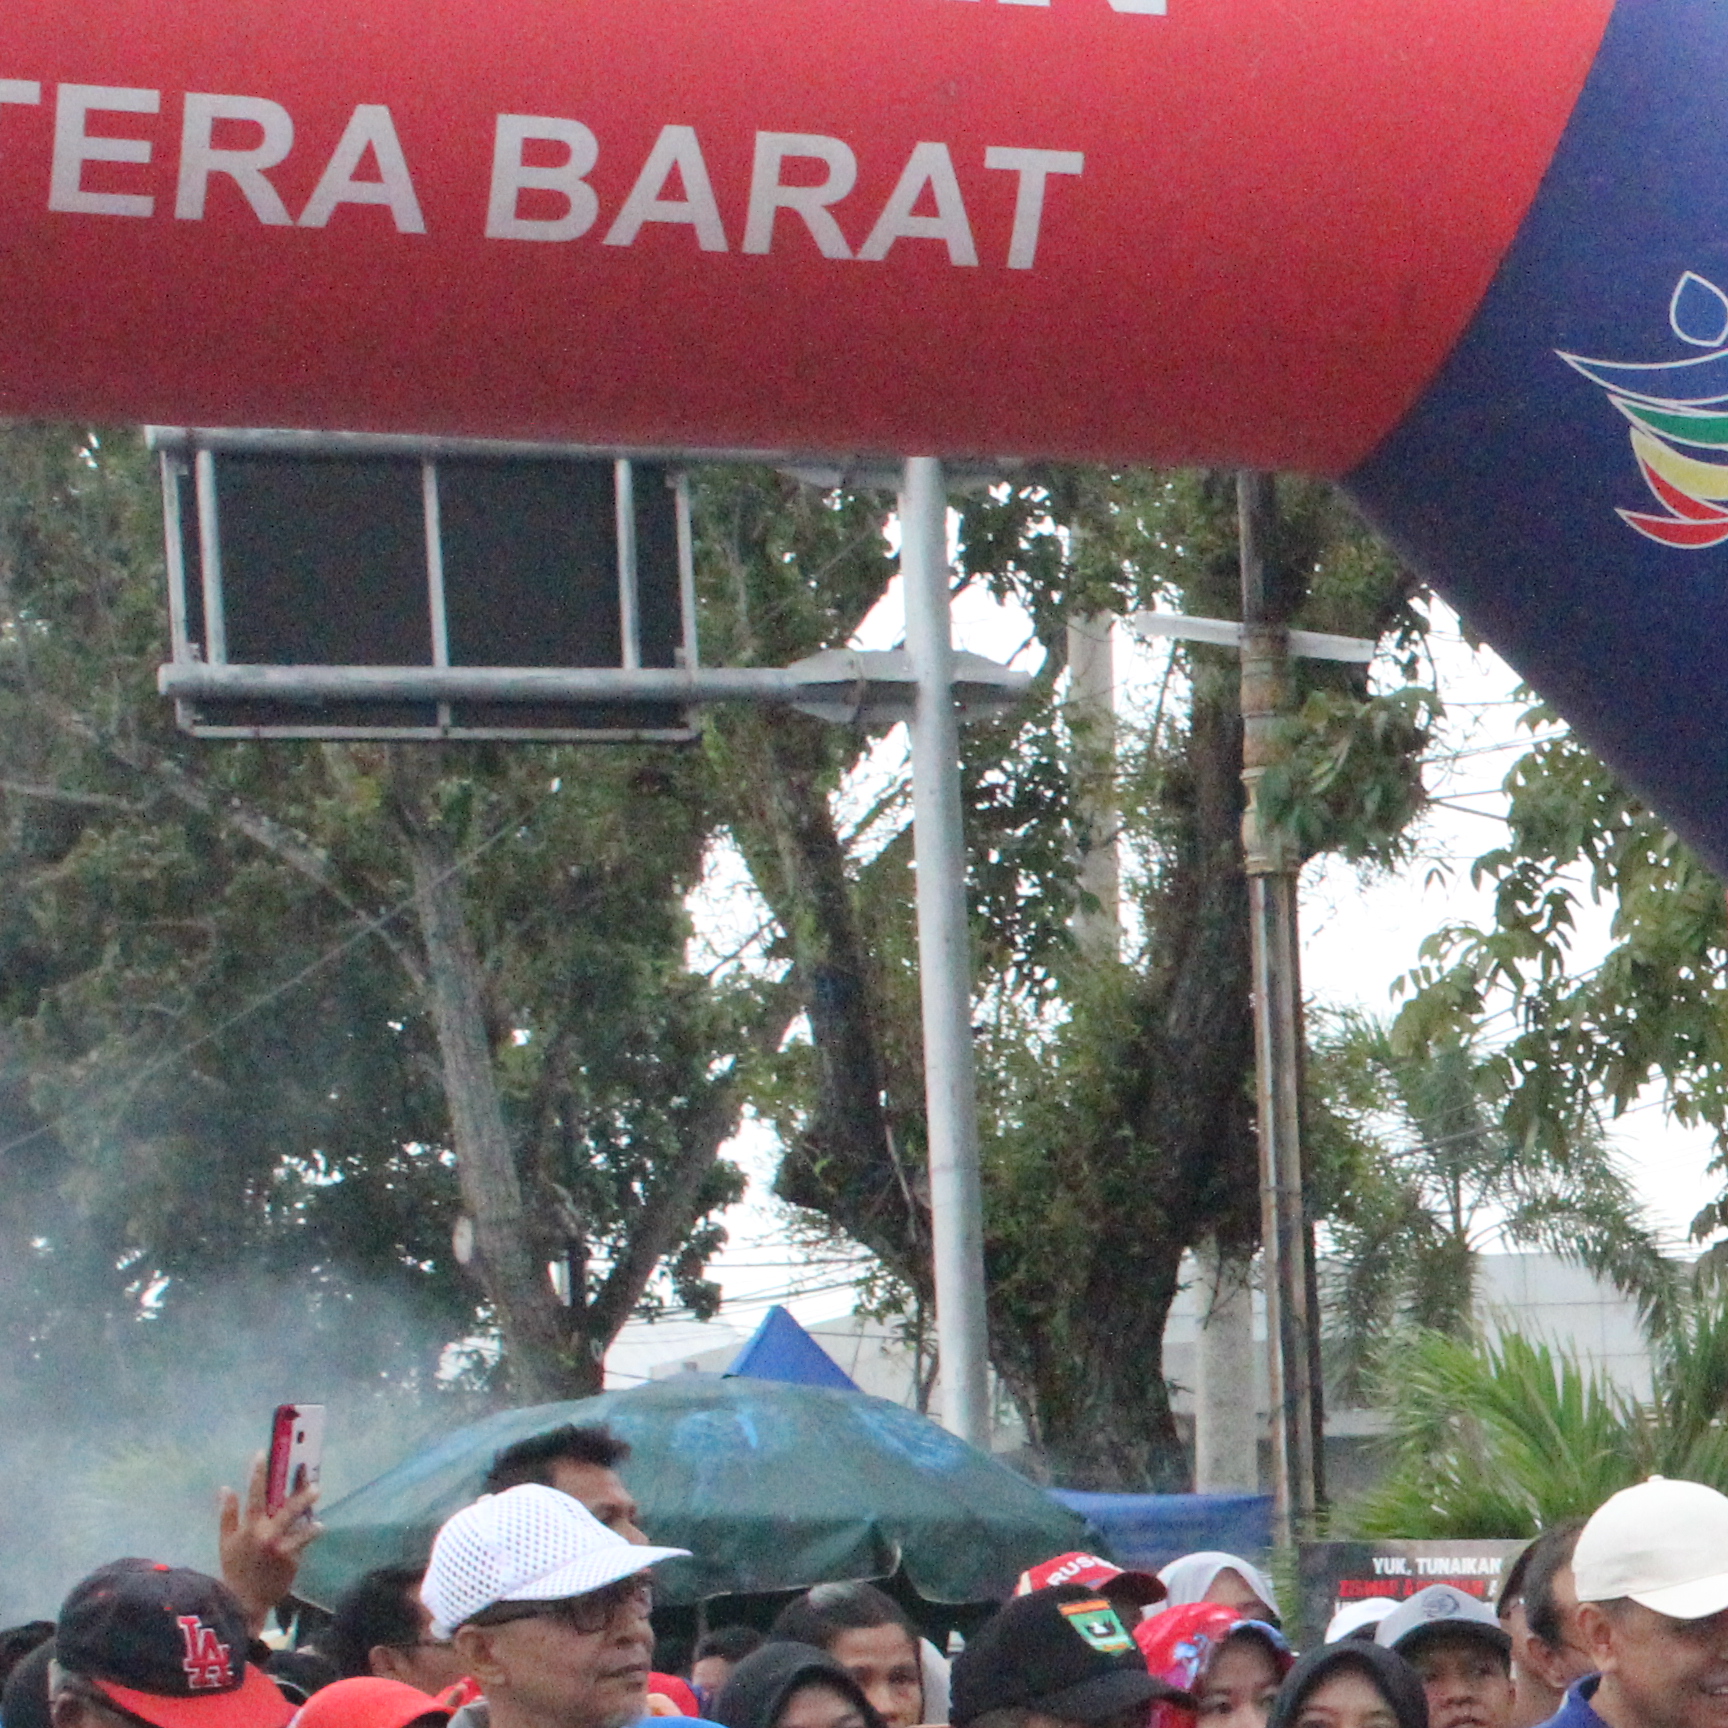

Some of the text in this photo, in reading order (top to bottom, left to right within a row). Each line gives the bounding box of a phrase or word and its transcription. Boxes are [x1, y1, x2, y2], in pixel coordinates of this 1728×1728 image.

[484, 112, 1085, 270] BARAT
[1415, 1557, 1502, 1575] TUNAIKAN
[176, 1615, 234, 1689] LA
